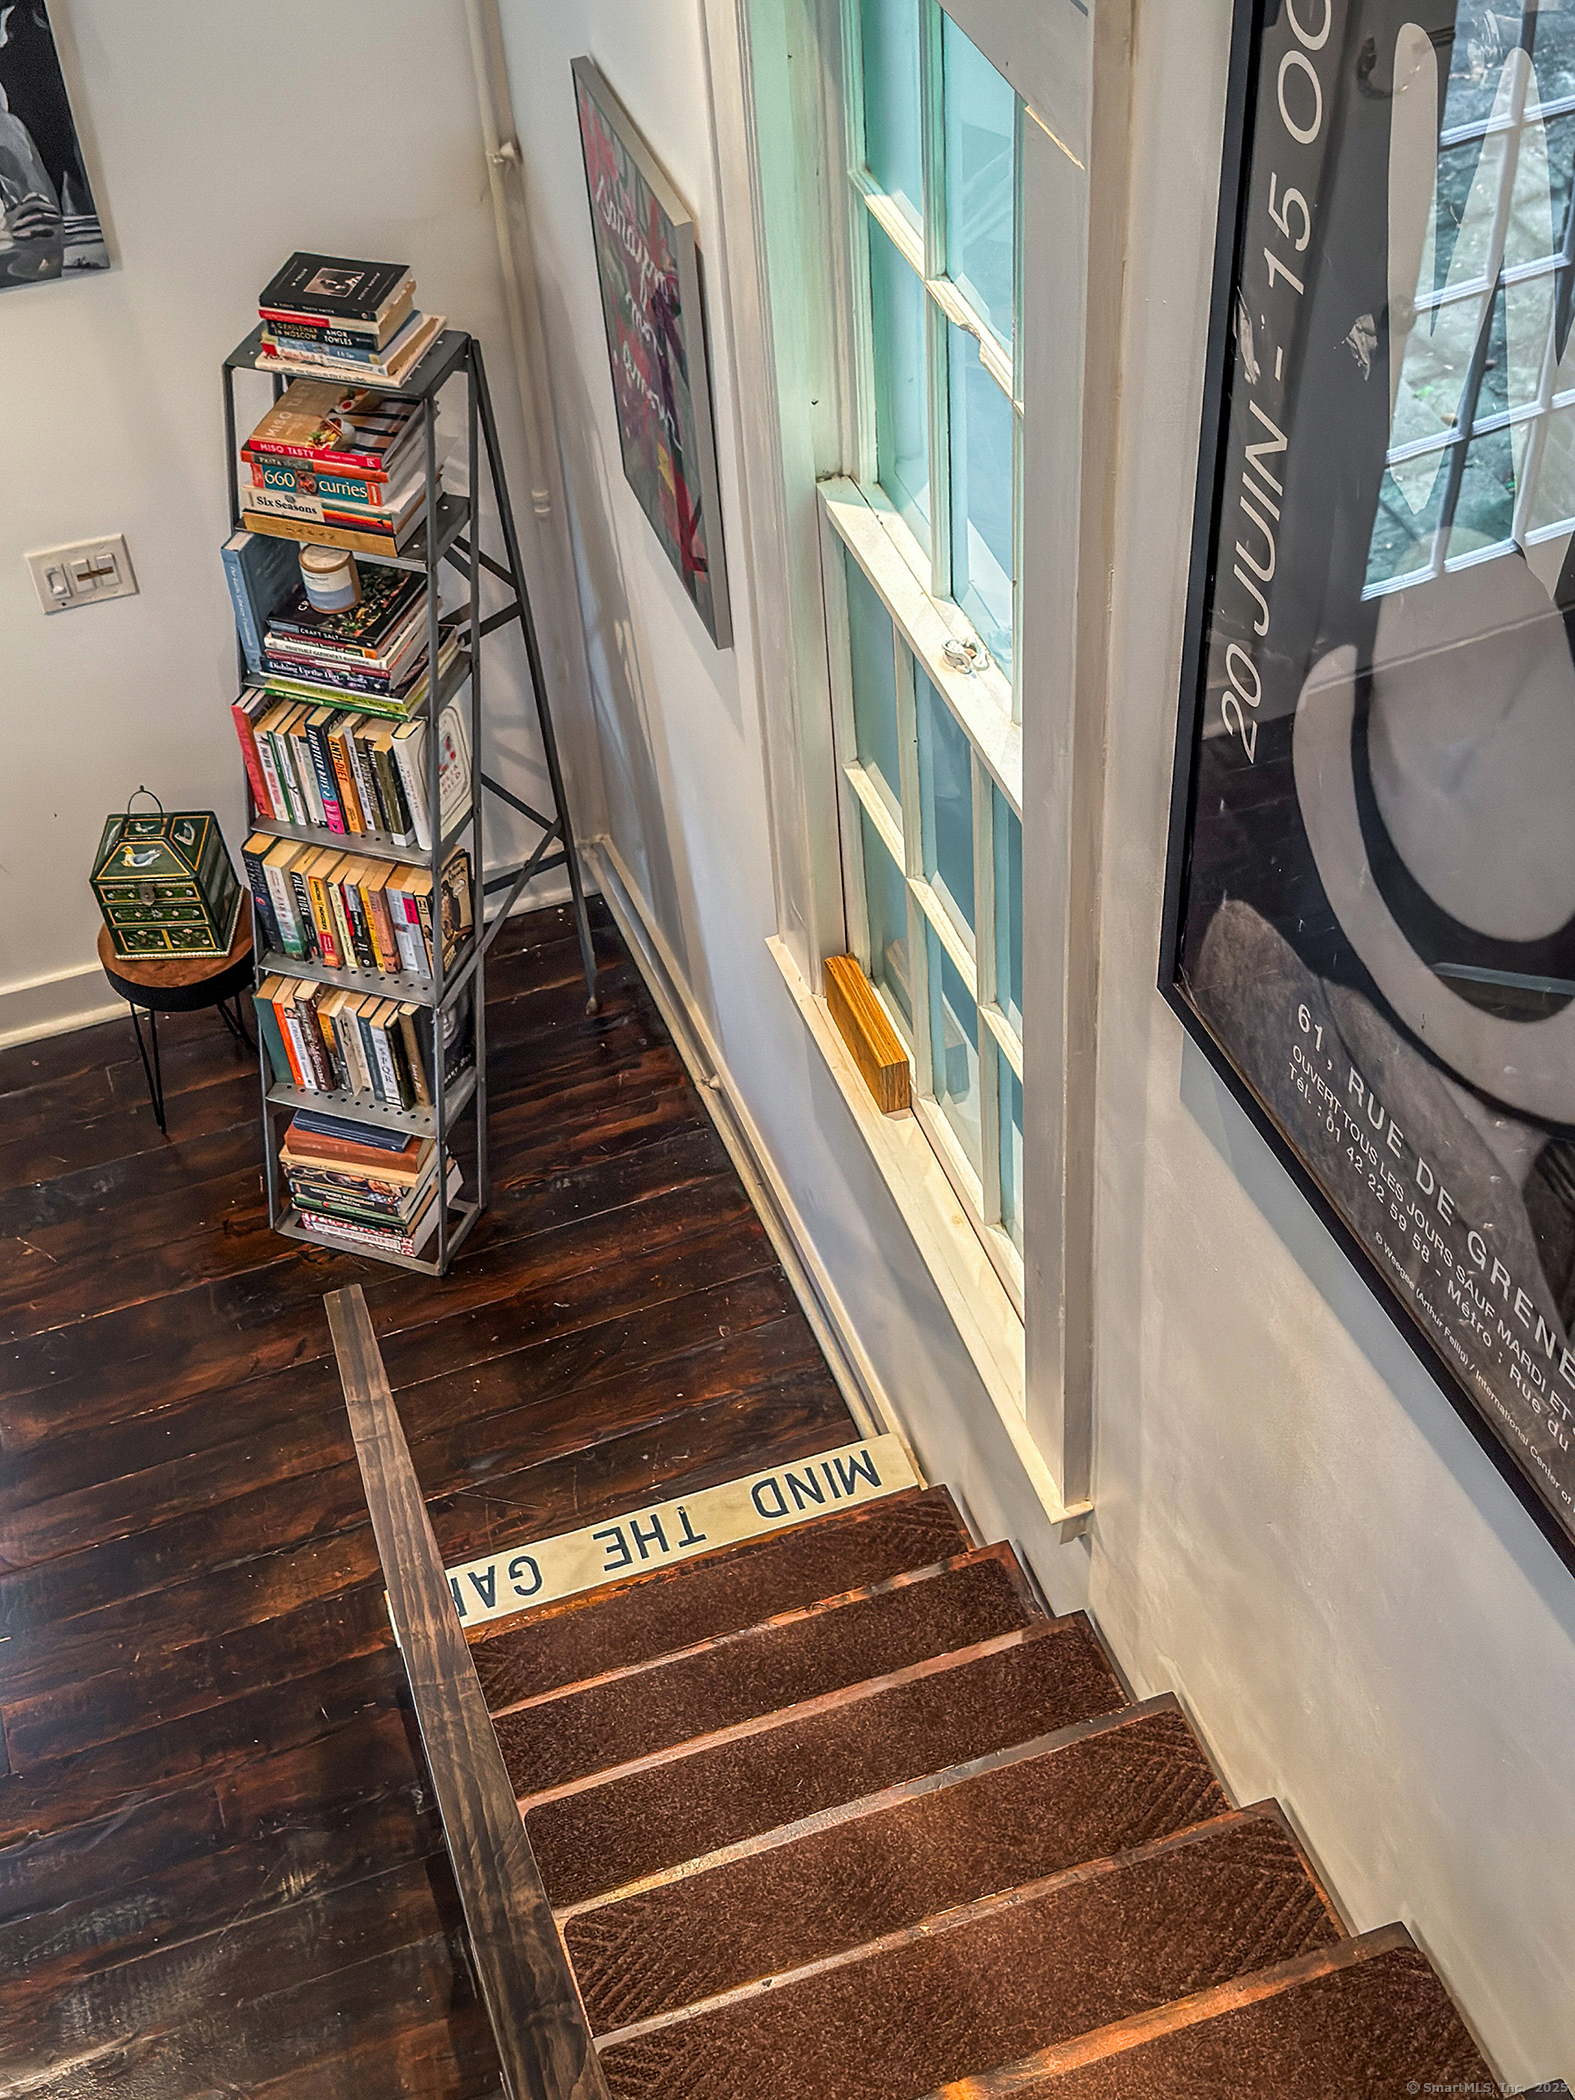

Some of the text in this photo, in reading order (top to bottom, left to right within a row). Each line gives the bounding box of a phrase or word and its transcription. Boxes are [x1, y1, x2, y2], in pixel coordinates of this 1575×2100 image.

[1264, 171, 1311, 295] 15
[284, 331, 317, 341] MOSCOW
[323, 335, 353, 346] TOWLES
[326, 329, 348, 338] AMOR
[260, 443, 283, 454] MISO
[287, 447, 314, 459] TASTY
[256, 496, 318, 515] Six Seasons
[264, 469, 368, 498] 660 curries
[1233, 399, 1288, 637] JUIN
[300, 628, 321, 637] CRAFT
[1221, 642, 1262, 764] 20
[307, 729, 330, 790] FOURTEEN DAYS
[330, 740, 349, 782] ANTI-DIET
[291, 874, 305, 896] PALE
[297, 896, 310, 916] RIDER
[1348, 1066, 1404, 1159] RUE
[1415, 1157, 1455, 1226] DE
[1293, 1045, 1574, 1421] OUVERT TOUS LES JOURS SAUF MARDI ET
[1326, 1115, 1341, 1142] 01
[1346, 1146, 1364, 1175] 42
[1368, 1173, 1385, 1204] 22
[1389, 1202, 1407, 1232] 59
[1412, 1232, 1430, 1263] 58
[1447, 1279, 1492, 1347] Métro
[1510, 1364, 1541, 1414] Rue
[1548, 1419, 1569, 1452] du
[1384, 1242, 1415, 1291] Weegee
[1416, 1288, 1444, 1328] (Arthur
[1475, 1370, 1528, 1446] International
[1530, 1445, 1560, 1488] Center
[1561, 1490, 1572, 1505] of
[750, 1449, 883, 1519] MIND
[592, 1505, 707, 1573] THE
